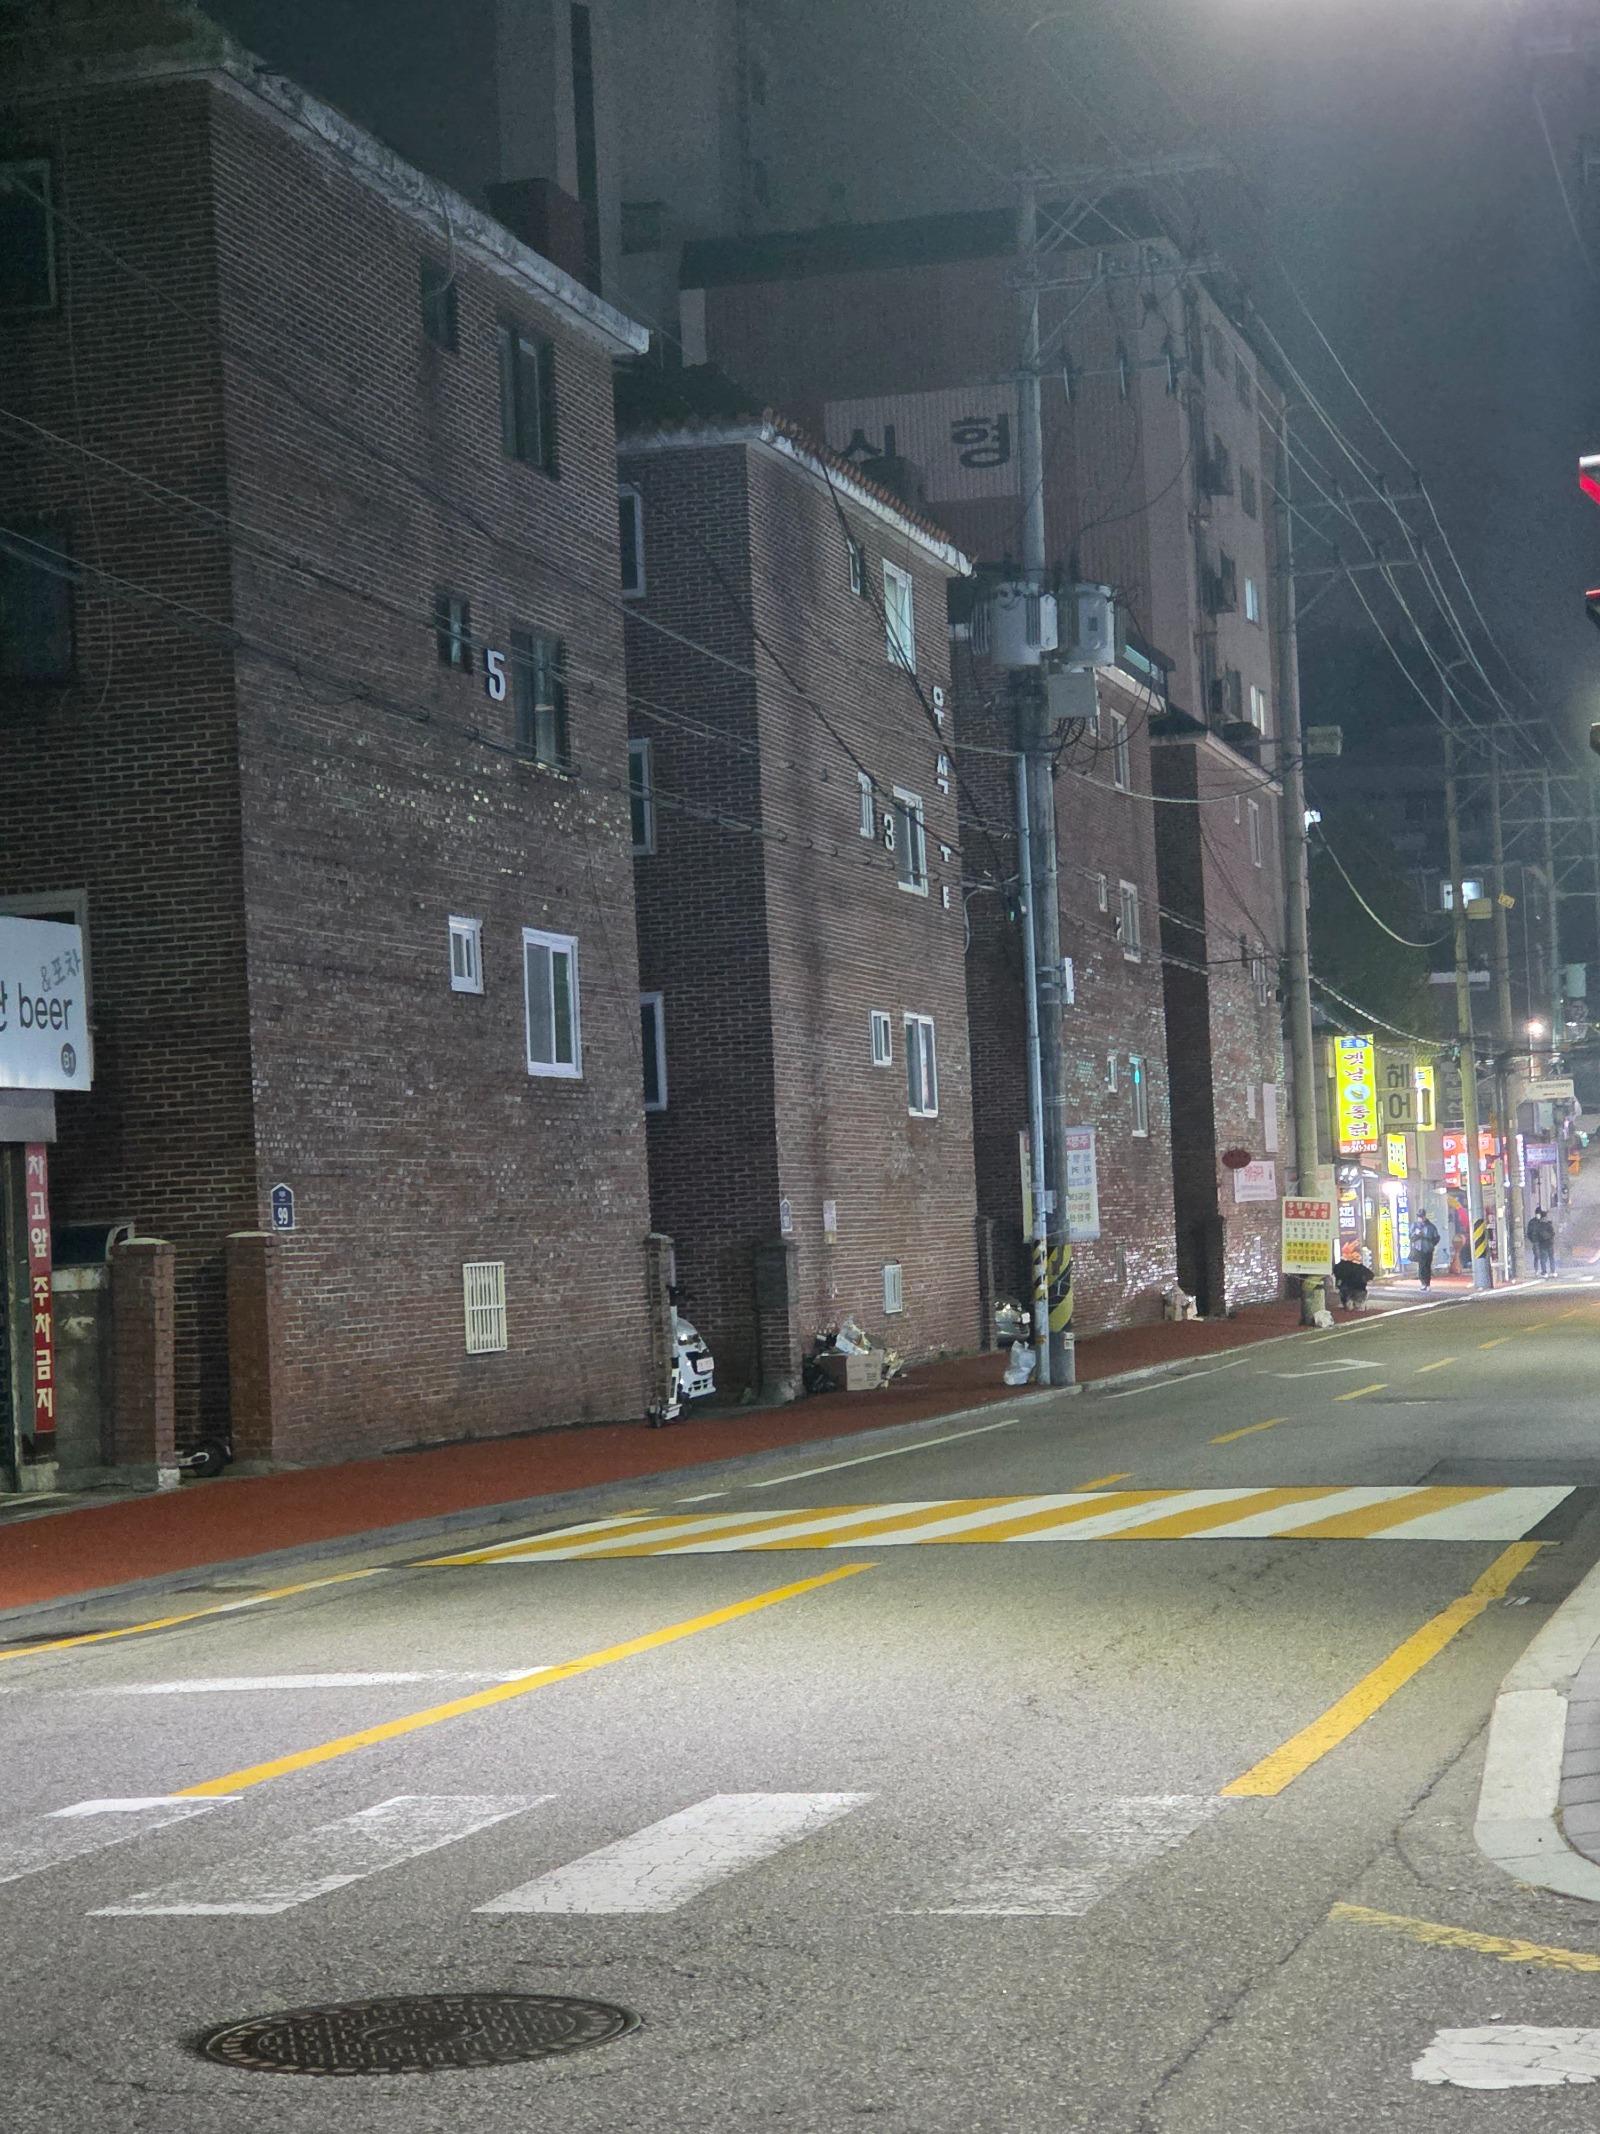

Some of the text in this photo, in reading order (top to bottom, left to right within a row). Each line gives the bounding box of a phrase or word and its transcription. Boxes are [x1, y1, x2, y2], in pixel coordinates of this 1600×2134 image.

[487, 649, 506, 701] 5
[884, 813, 895, 851] 3
[18, 982, 73, 1031] beer
[28, 1155, 49, 1259] 차고앞
[277, 1207, 288, 1225] 99
[33, 1276, 53, 1418] 주차금지
